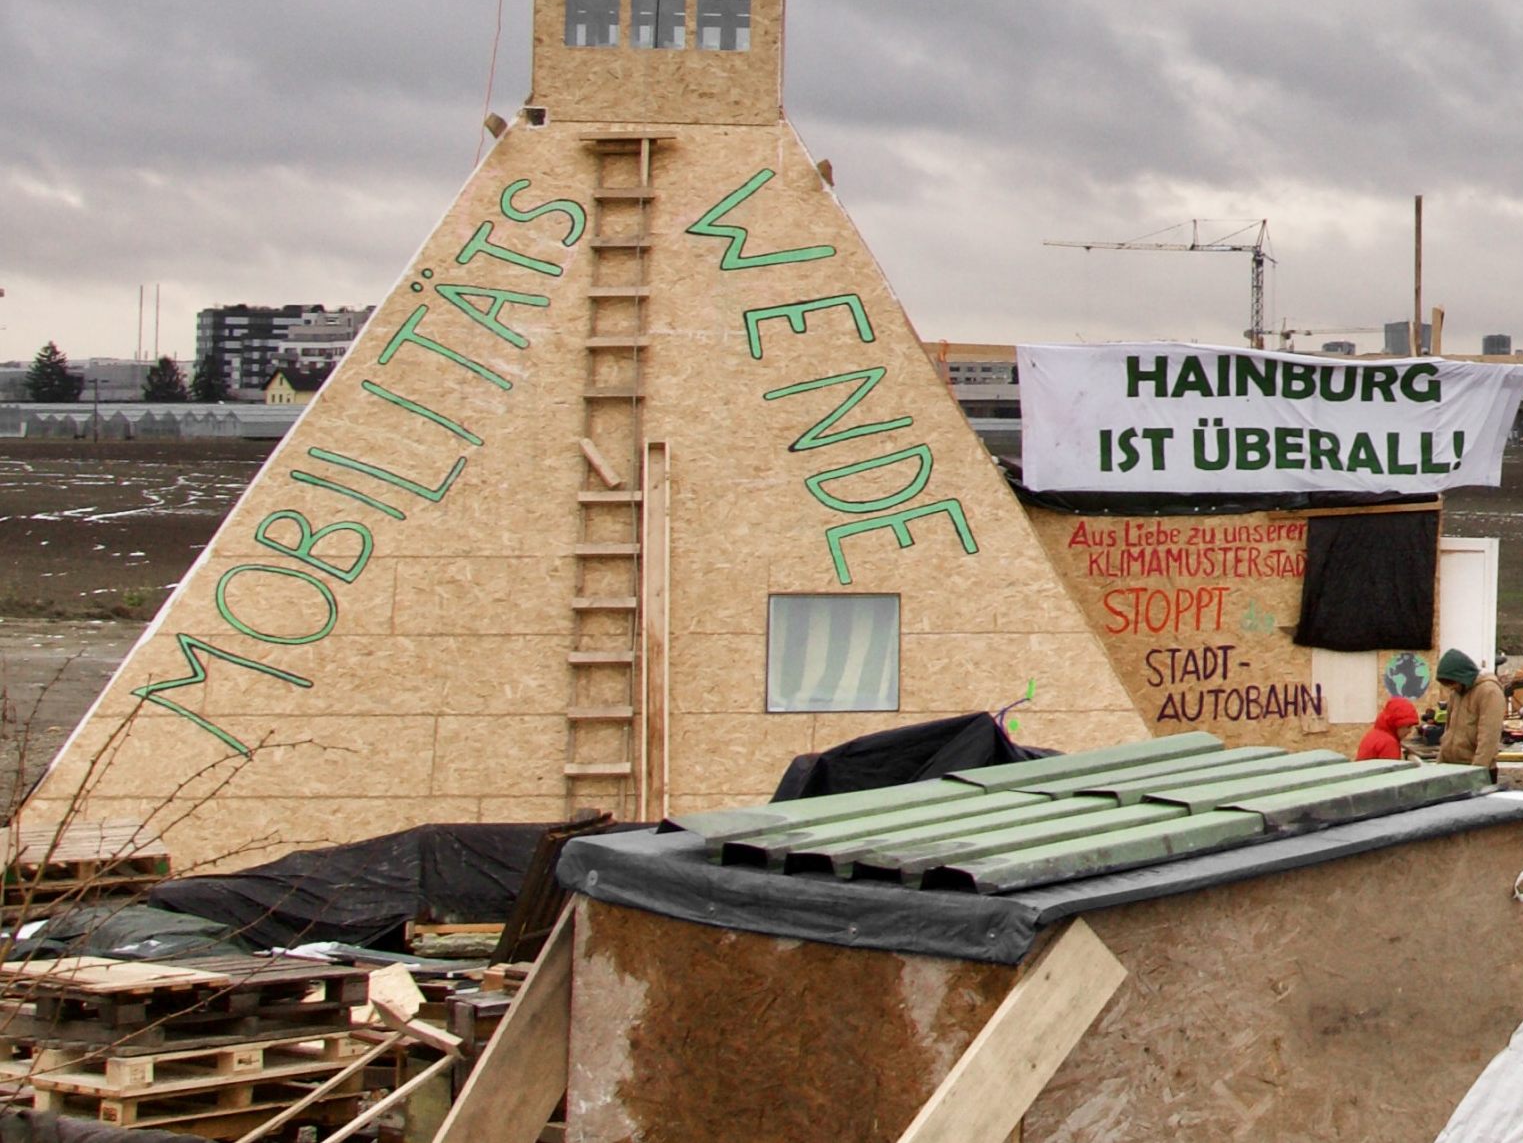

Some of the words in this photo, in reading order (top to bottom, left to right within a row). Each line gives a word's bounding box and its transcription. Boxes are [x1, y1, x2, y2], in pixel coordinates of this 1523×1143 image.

[685, 168, 980, 585] WENDE
[1126, 355, 1442, 403] HAINBURG
[130, 178, 588, 758] MOBILITÄTS
[1099, 428, 1174, 473] IST
[1193, 418, 1465, 475] ÜBERALL!
[1068, 520, 1117, 549] Aus
[1123, 520, 1182, 548] Liebe
[1186, 526, 1217, 547] zu
[1223, 522, 1307, 544] unserer
[1102, 585, 1232, 636] STOPPT
[1145, 644, 1251, 688] STADT-
[1156, 683, 1323, 723] AUTOBAHN
